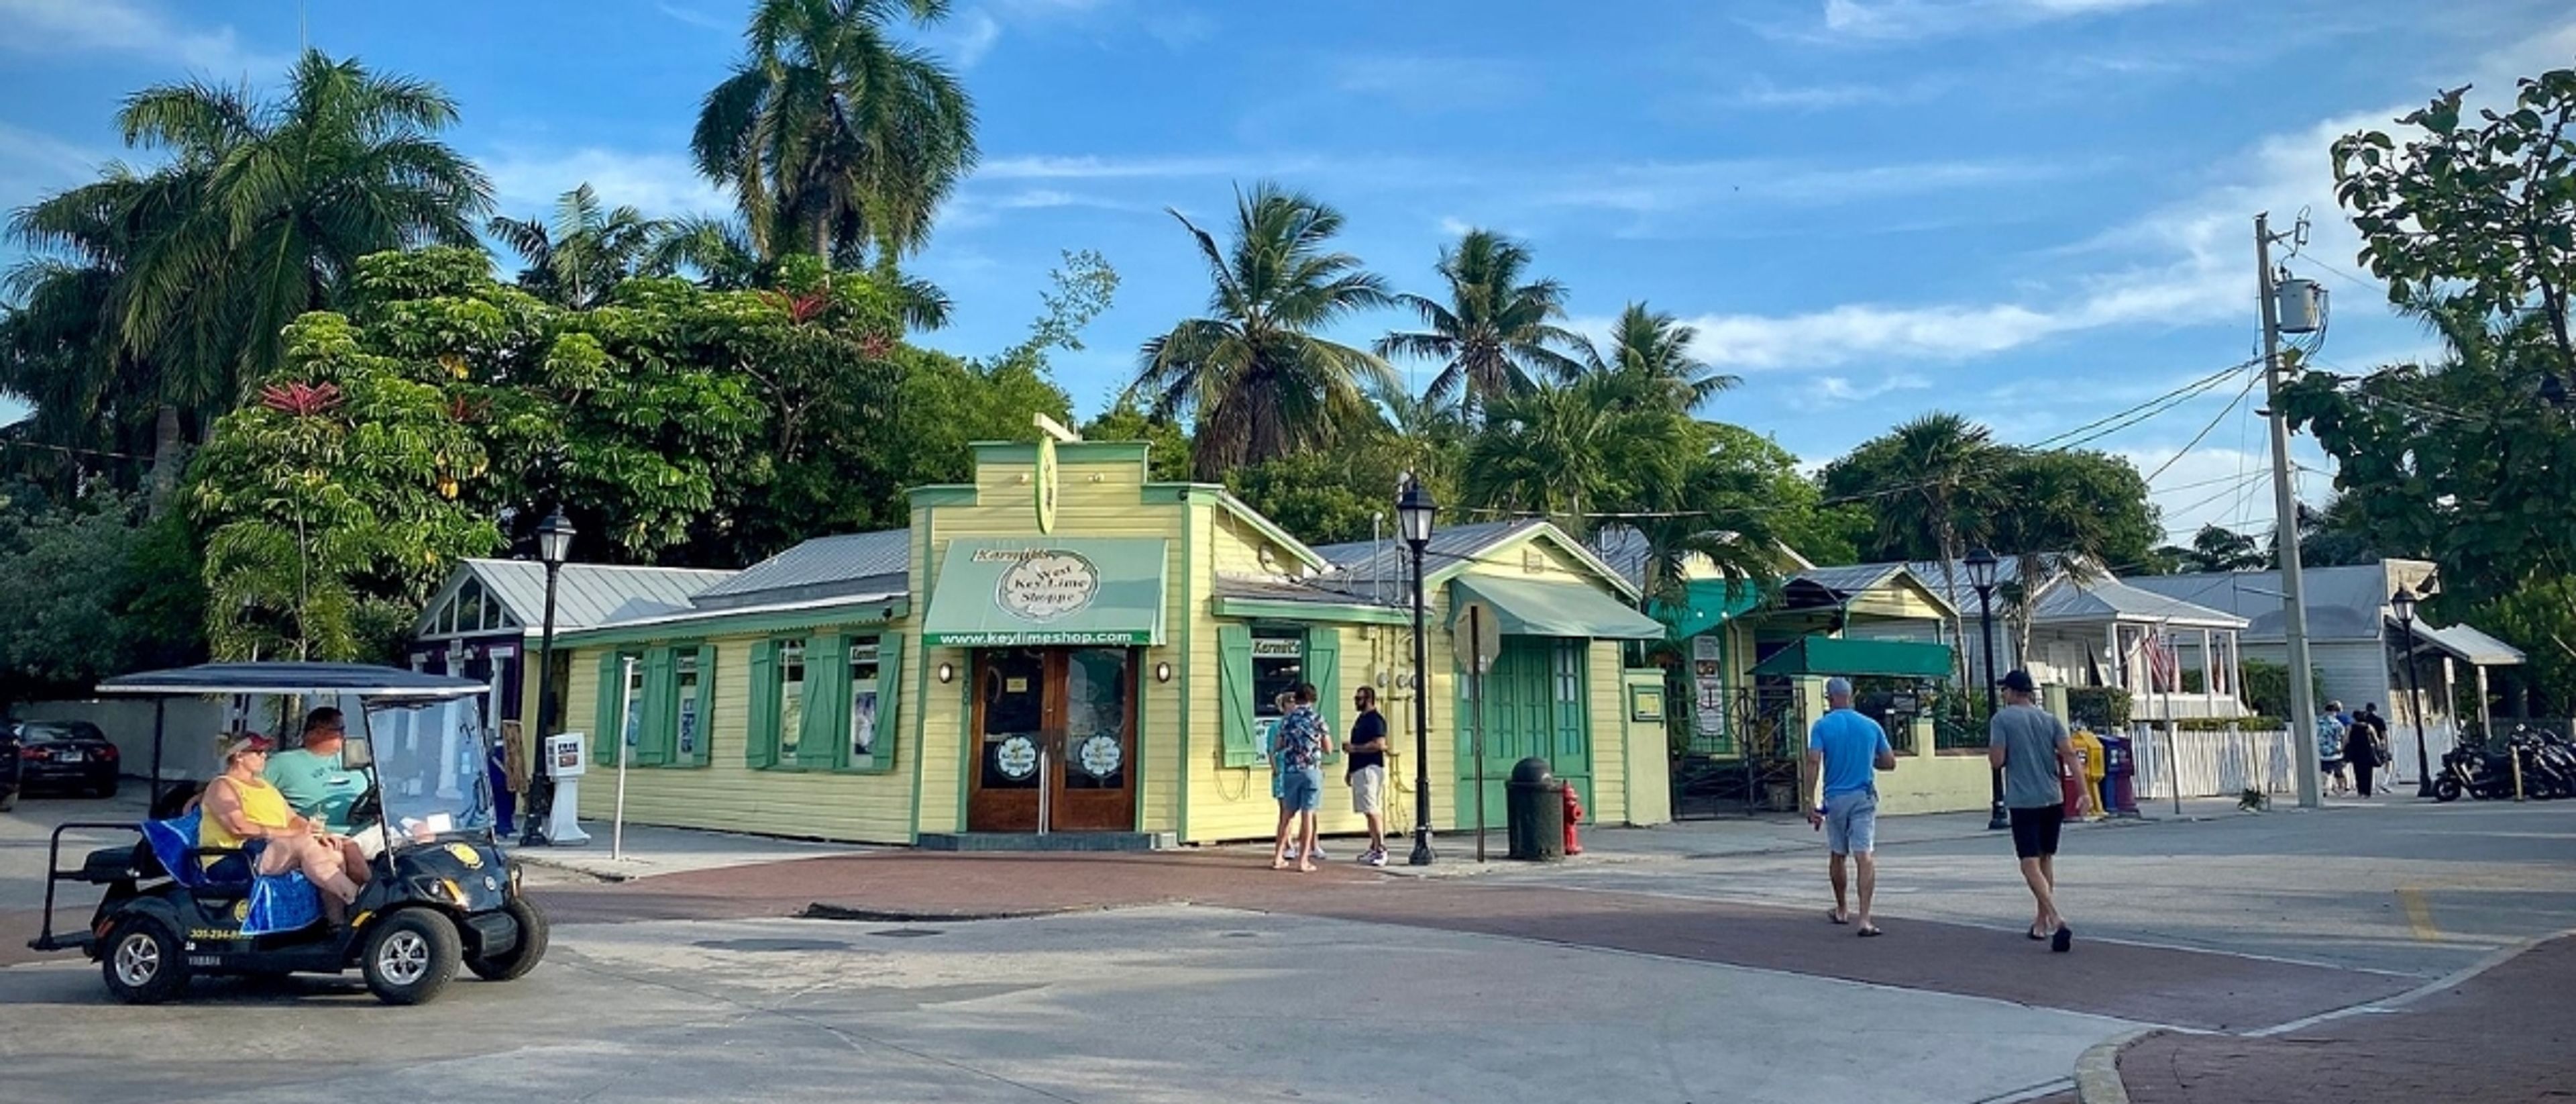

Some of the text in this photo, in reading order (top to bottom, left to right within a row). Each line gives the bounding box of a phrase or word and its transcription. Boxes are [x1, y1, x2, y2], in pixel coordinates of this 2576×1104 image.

[1036, 565, 1071, 581] West
[1015, 577, 1087, 589] Key Lime
[1020, 591, 1075, 604] Shoppe
[940, 632, 1133, 646] www.keylimeshop.com
